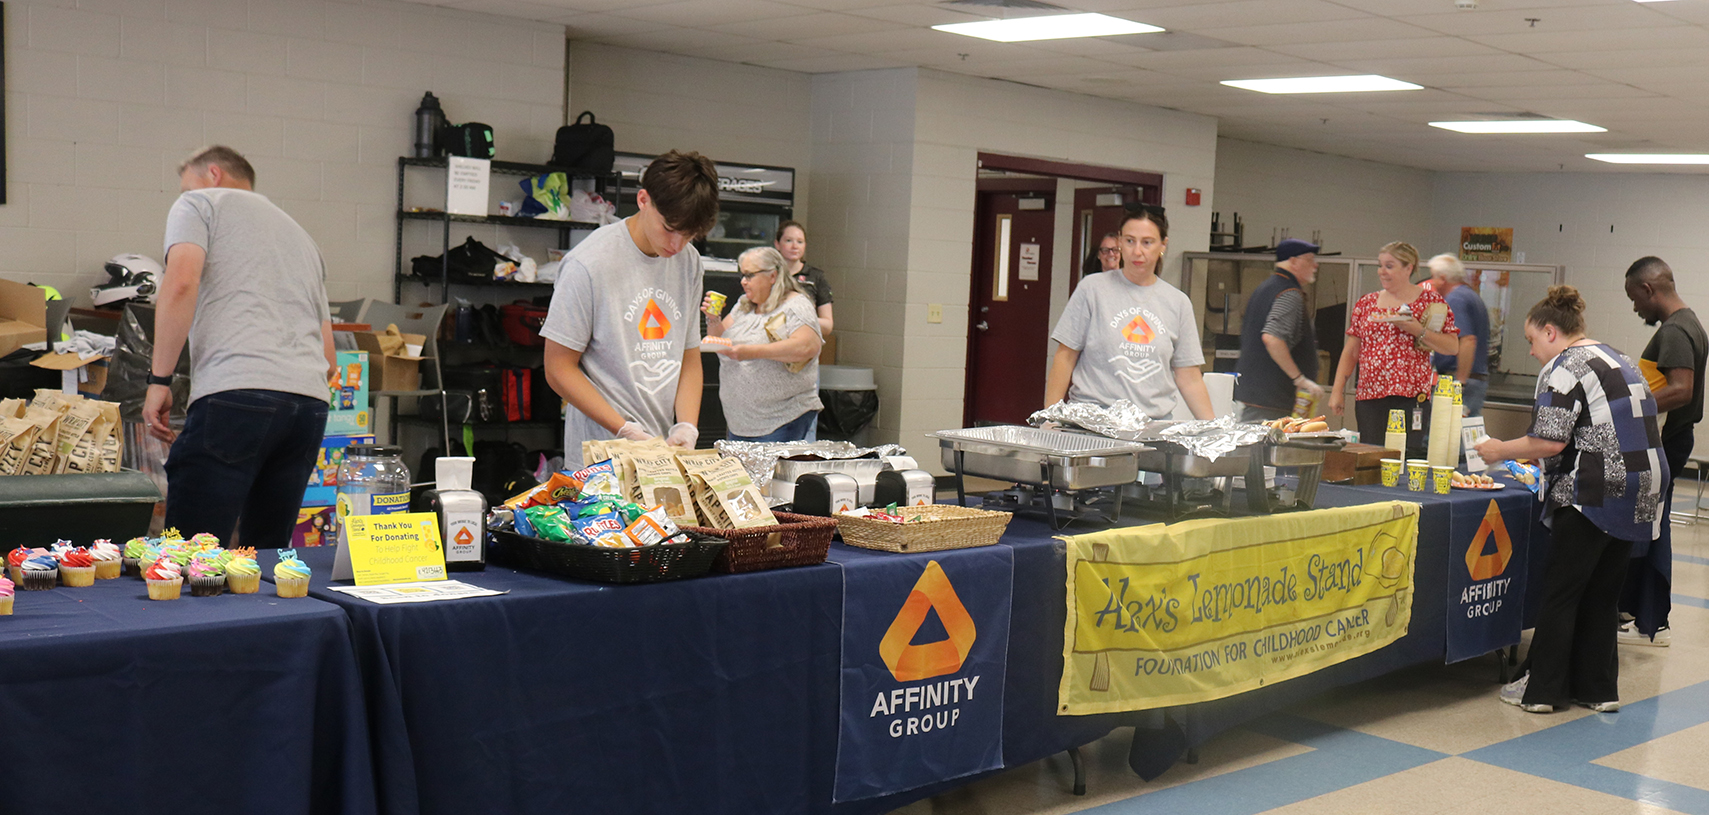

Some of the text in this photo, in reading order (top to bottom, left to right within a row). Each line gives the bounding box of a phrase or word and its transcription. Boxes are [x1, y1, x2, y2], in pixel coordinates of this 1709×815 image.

[1463, 242, 1492, 250] Custom
[624, 288, 682, 322] DAYS OF GIVING
[1110, 307, 1166, 334] DAYS OF GIVING
[634, 341, 672, 352] AFFINITY
[1119, 342, 1156, 353] AFFINITY
[573, 465, 612, 481] RUFFLES
[374, 522, 397, 530] Thank
[385, 533, 419, 541] Donating
[385, 545, 400, 553] Help
[402, 544, 418, 553] Fight
[369, 556, 403, 565] Childhood
[1095, 548, 1363, 633] Alex's Lemonade Stand
[1460, 577, 1511, 604] AFFINITY
[1467, 600, 1502, 618] GROUP
[1224, 642, 1247, 664] FOR
[1254, 624, 1321, 657] CHILDHOOD
[870, 676, 980, 717] AFFINITY
[889, 709, 960, 738] GROUP
